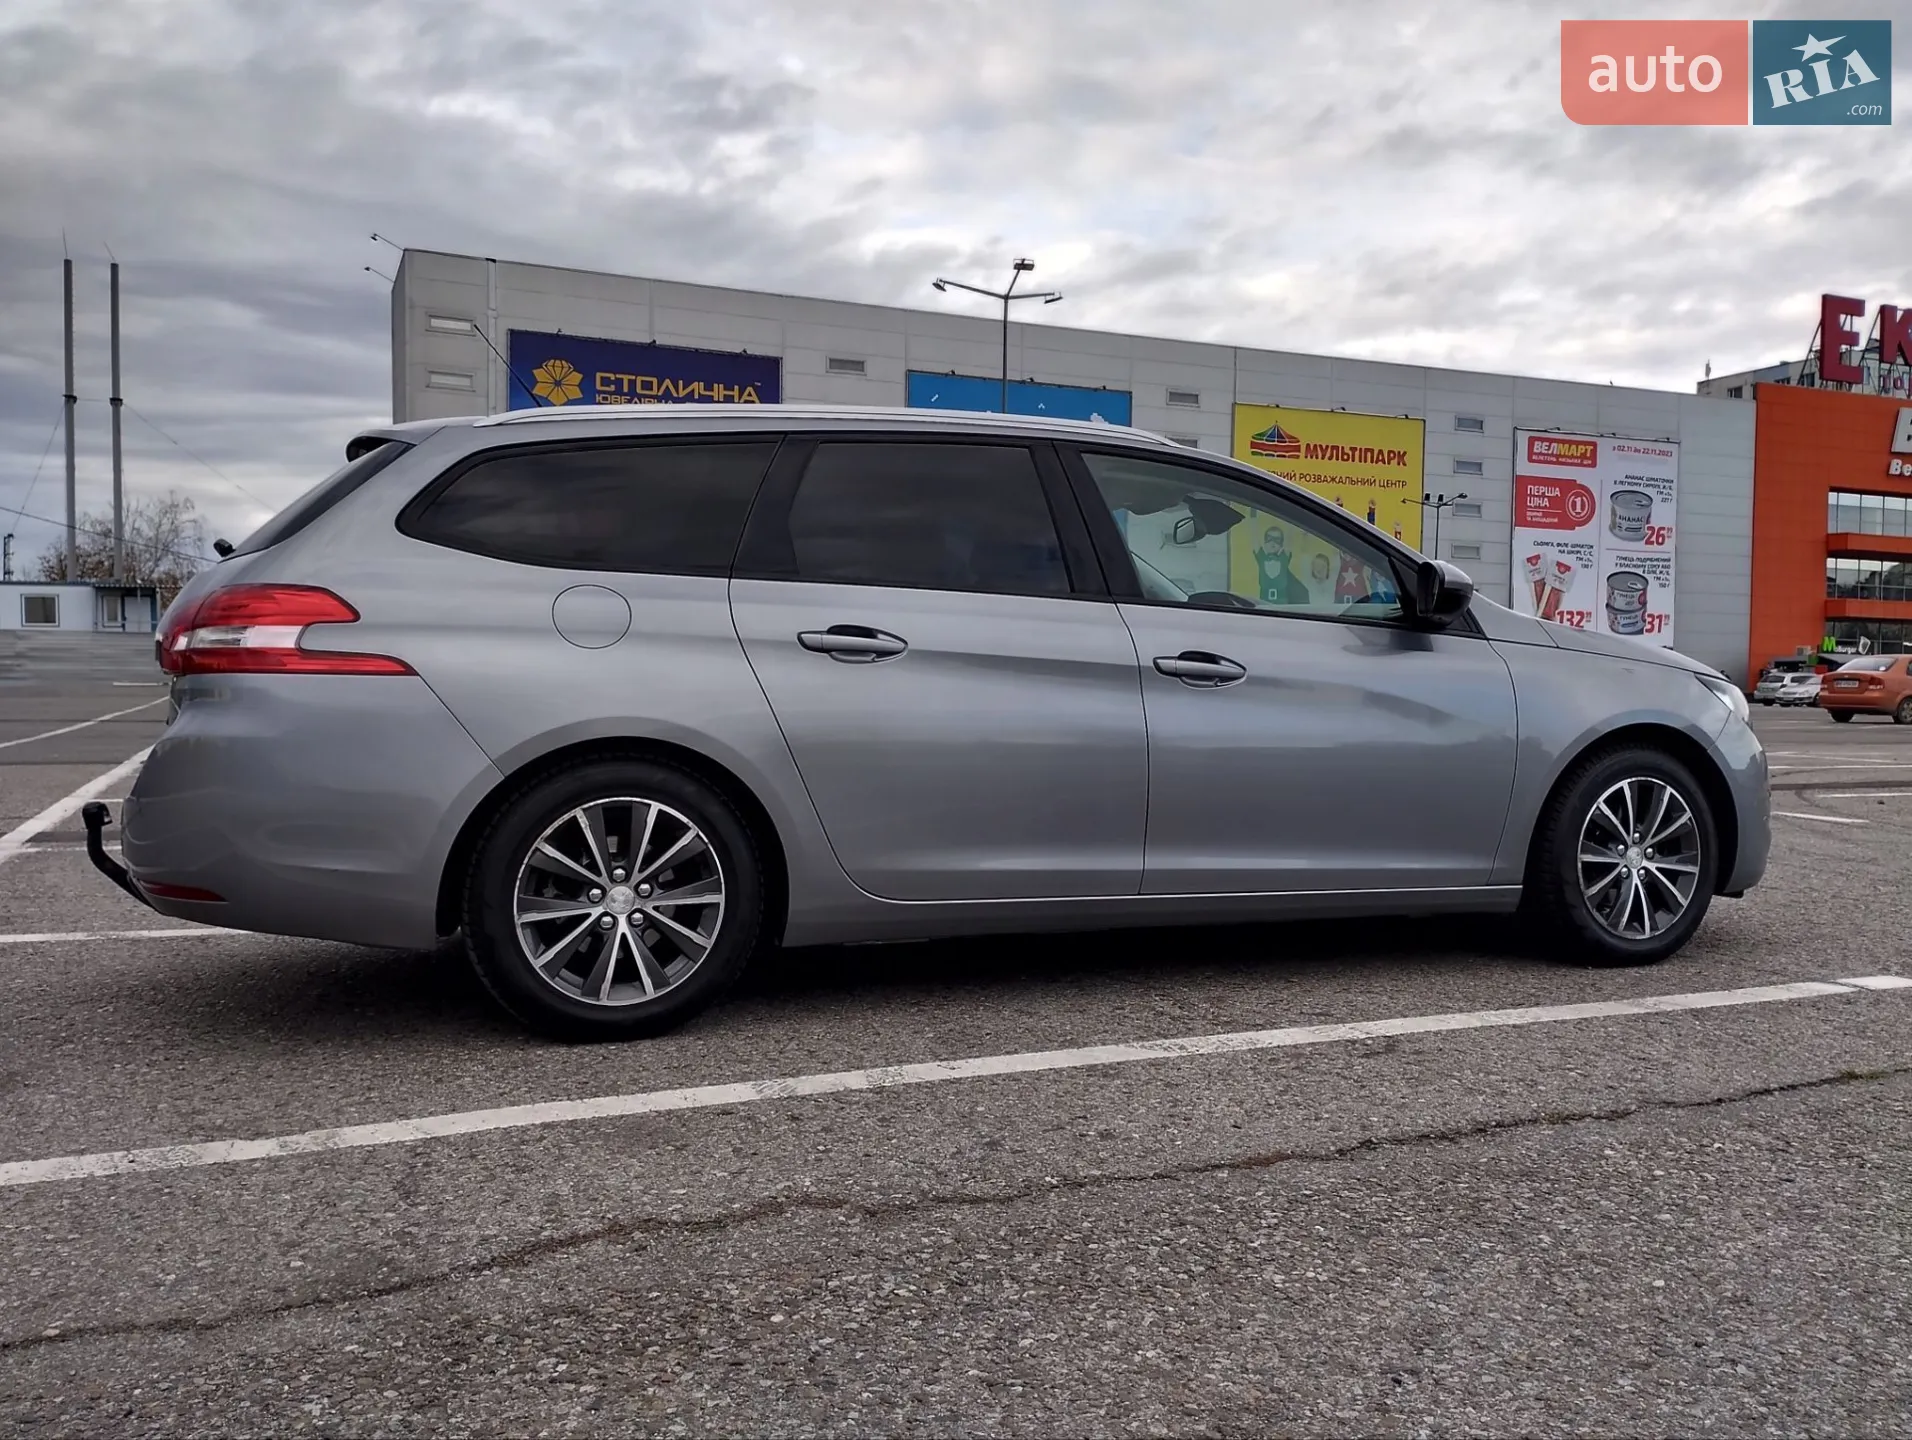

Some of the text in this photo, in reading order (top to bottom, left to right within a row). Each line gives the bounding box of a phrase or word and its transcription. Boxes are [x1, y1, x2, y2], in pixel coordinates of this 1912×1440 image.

[595, 371, 760, 404] СТОЛИЧНА
[1304, 443, 1407, 467] МУЛЬТІПАРК
[1533, 441, 1594, 457] ВЕЛМАРТ
[1299, 472, 1377, 487] РОЗВАЖАЛЬНИЙ
[1378, 480, 1407, 489] ЦЕНТР
[1527, 485, 1561, 497] ПЕРША
[1526, 496, 1550, 507] ЦІНА
[1645, 525, 1666, 546] 26
[1557, 610, 1585, 628] 132
[1645, 613, 1663, 633] 31
